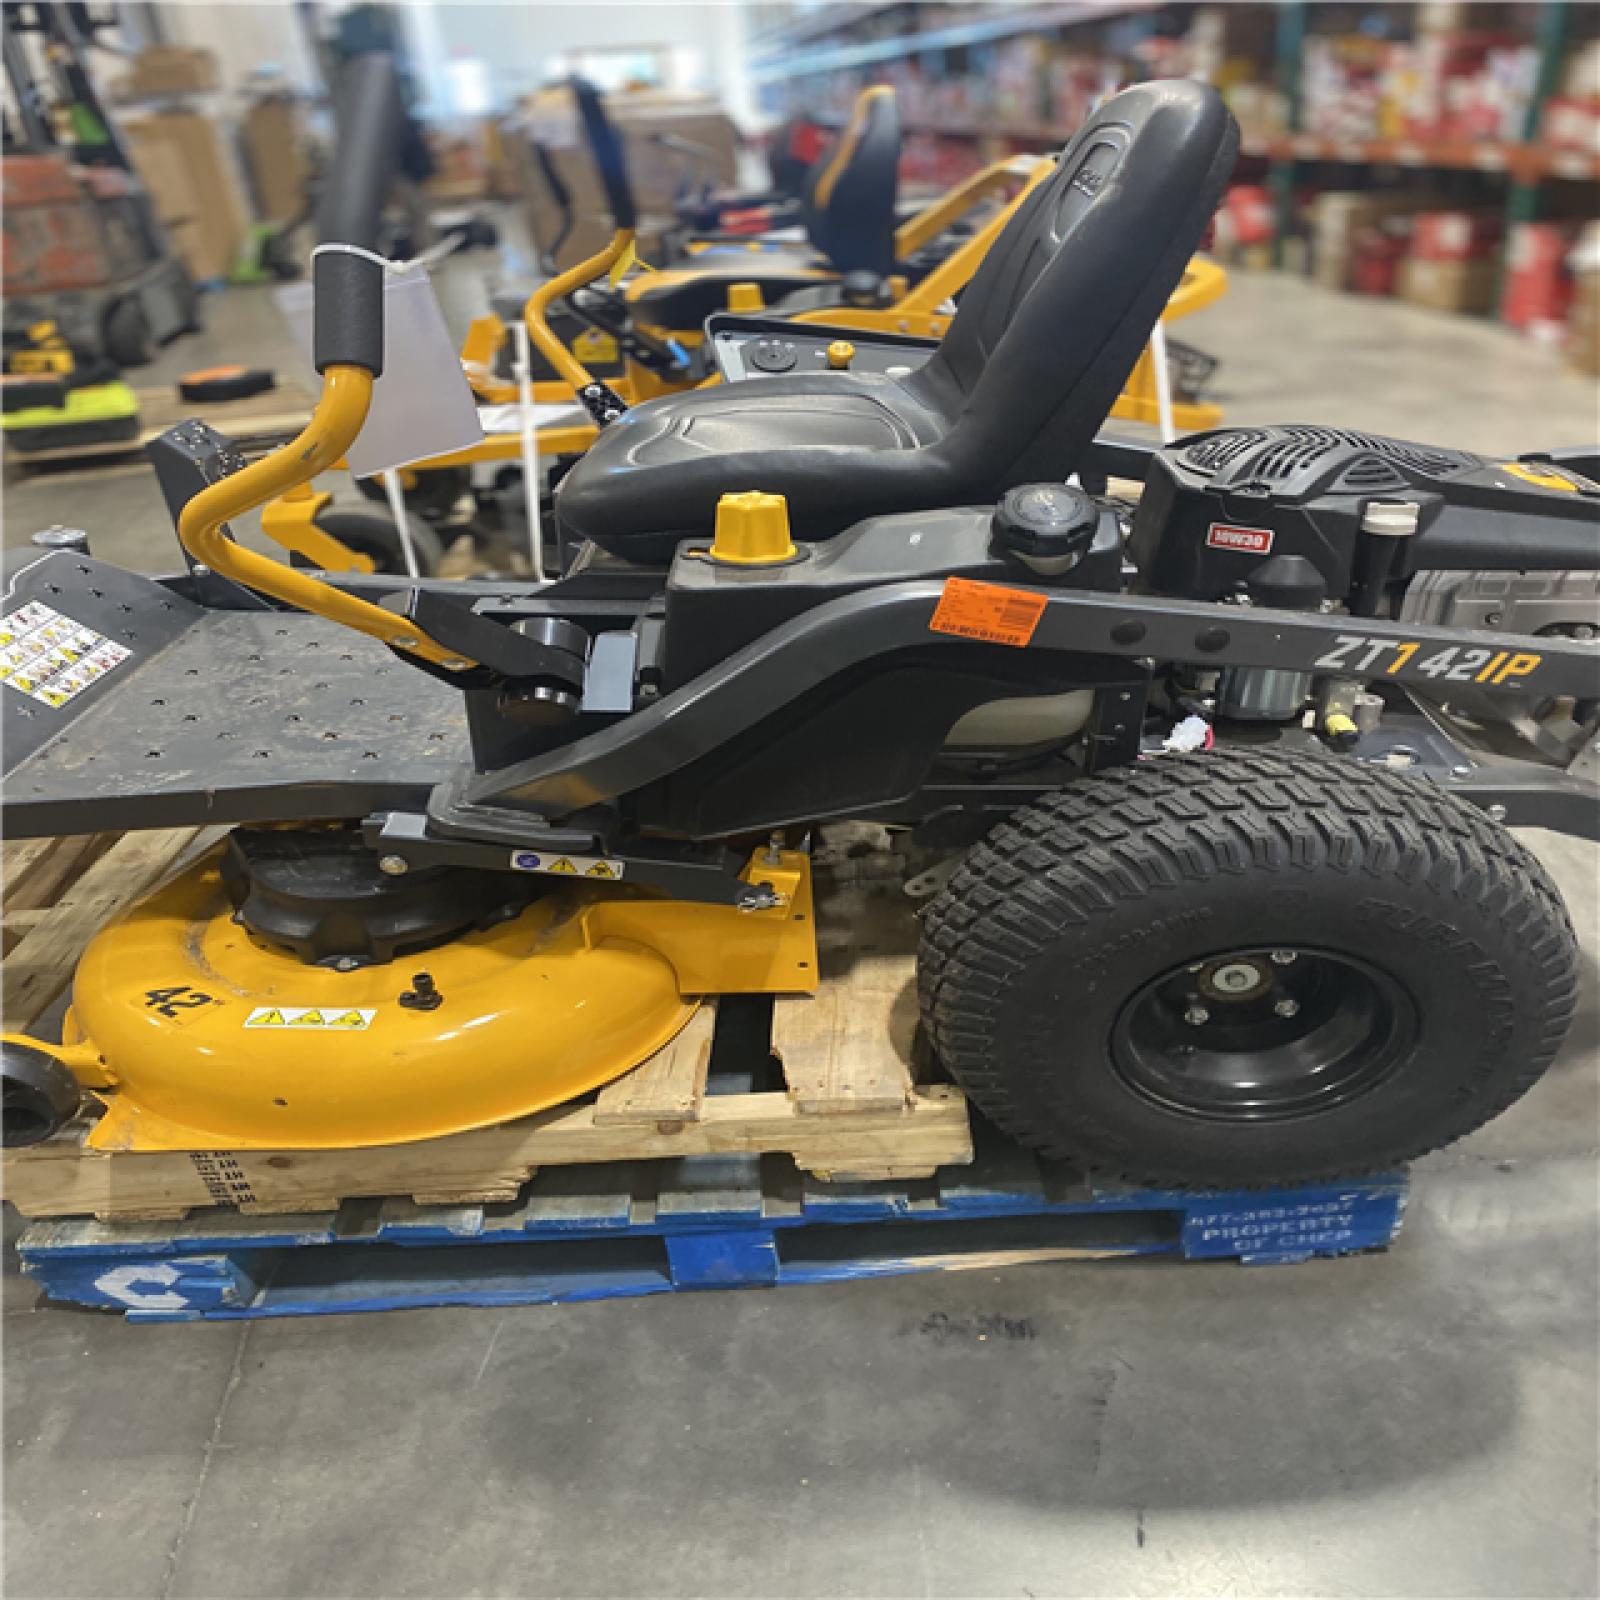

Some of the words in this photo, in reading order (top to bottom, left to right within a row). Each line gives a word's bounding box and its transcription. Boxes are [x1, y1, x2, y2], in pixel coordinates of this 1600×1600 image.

[1314, 634, 1421, 675] ZT1
[1417, 646, 1542, 684] 42IP
[1202, 1214, 1353, 1241] PROPERTY
